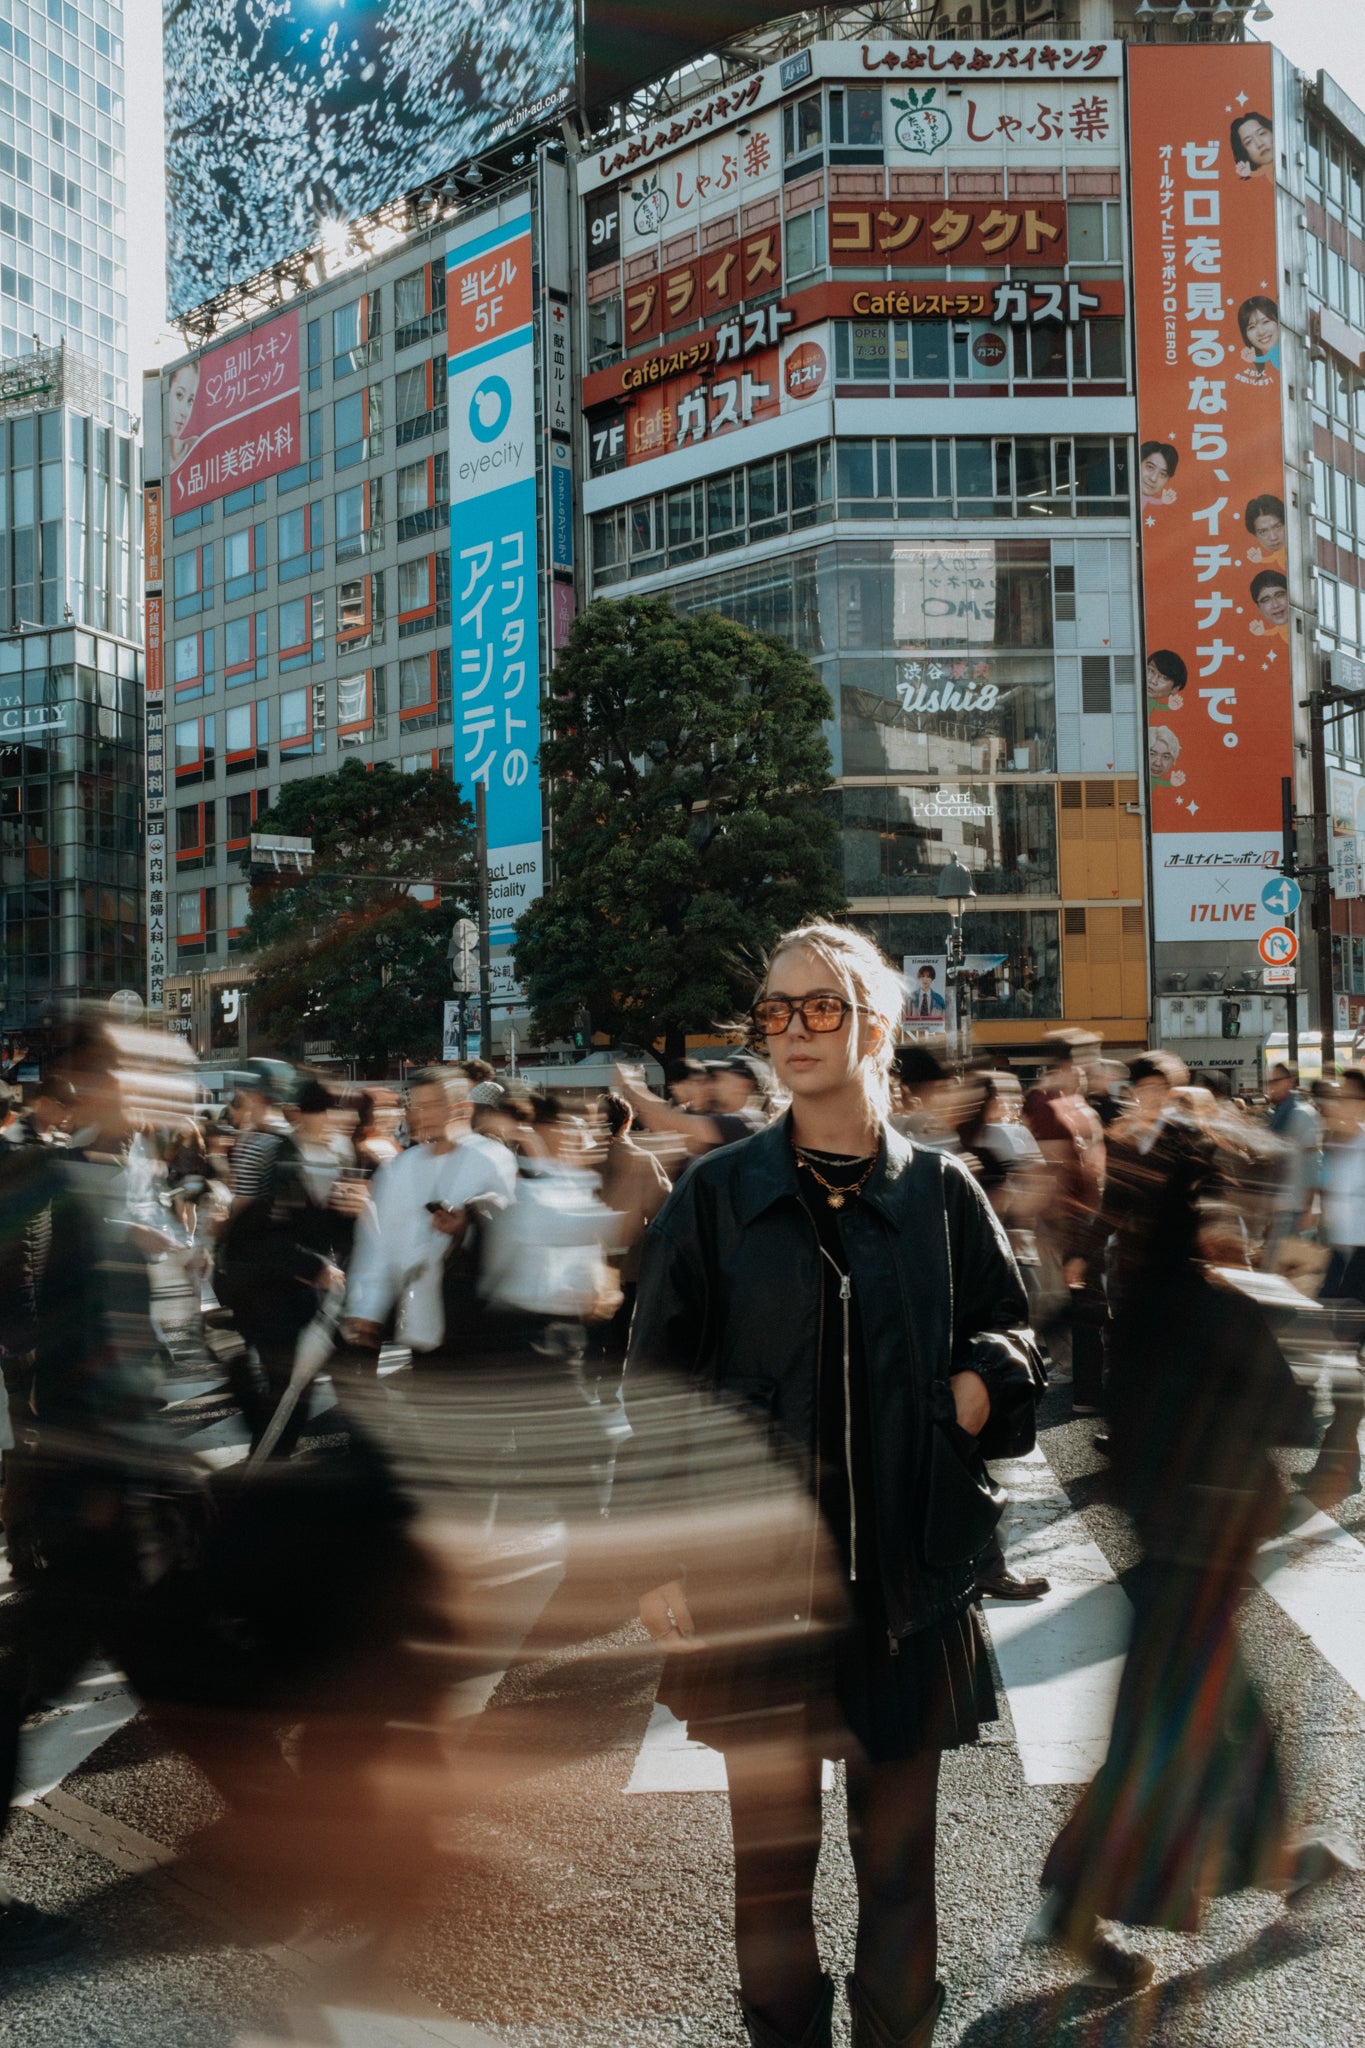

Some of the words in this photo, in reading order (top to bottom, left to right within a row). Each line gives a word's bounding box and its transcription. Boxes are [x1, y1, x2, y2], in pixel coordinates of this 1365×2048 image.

[861, 44, 1107, 71] しゃぶしゃぶバイキング
[492, 87, 569, 134] www.hit-ad.co.jp
[599, 75, 764, 177] しゃぶしゃぶバイキング
[967, 95, 1109, 142] しゃぶ葉
[675, 132, 771, 208] しゃぶ葉
[591, 211, 618, 245] 9F
[832, 208, 1058, 252] コンタクト
[461, 258, 518, 306] 当ビル
[627, 235, 777, 332] プライス
[993, 281, 1099, 323] ガスト
[475, 295, 504, 333] 5F
[715, 304, 793, 364] ガスト
[855, 328, 886, 338] OPEN
[224, 332, 293, 381] 品川スキン
[978, 347, 1003, 357] ガスト
[225, 362, 286, 409] クリニック
[553, 333, 565, 416] 献血ルーム
[790, 364, 822, 388] ガスト
[555, 418, 565, 429] 6F
[633, 406, 672, 439] Café
[676, 373, 771, 448] ガスト
[188, 423, 293, 497] 品川美容外科
[459, 440, 523, 484] eyecity
[593, 424, 624, 462] 7F
[1180, 140, 1239, 749] ゼロを見るなら、イチナナで。
[149, 505, 158, 578] 東京スター銀行
[460, 540, 498, 792] アイシティ
[501, 531, 529, 787] コンタクトの
[904, 662, 944, 680] 渋谷
[3, 704, 66, 727] CITY
[896, 680, 999, 712] Ushi8
[147, 713, 162, 793] 加藤眼科
[149, 801, 162, 809] 5F
[149, 824, 163, 836] 3F
[150, 858, 163, 884] 内科
[509, 859, 536, 876] Lens
[487, 882, 526, 899] eciality
[1190, 903, 1256, 922] 17LIVE
[1209, 1059, 1244, 1067] EKIMAE
